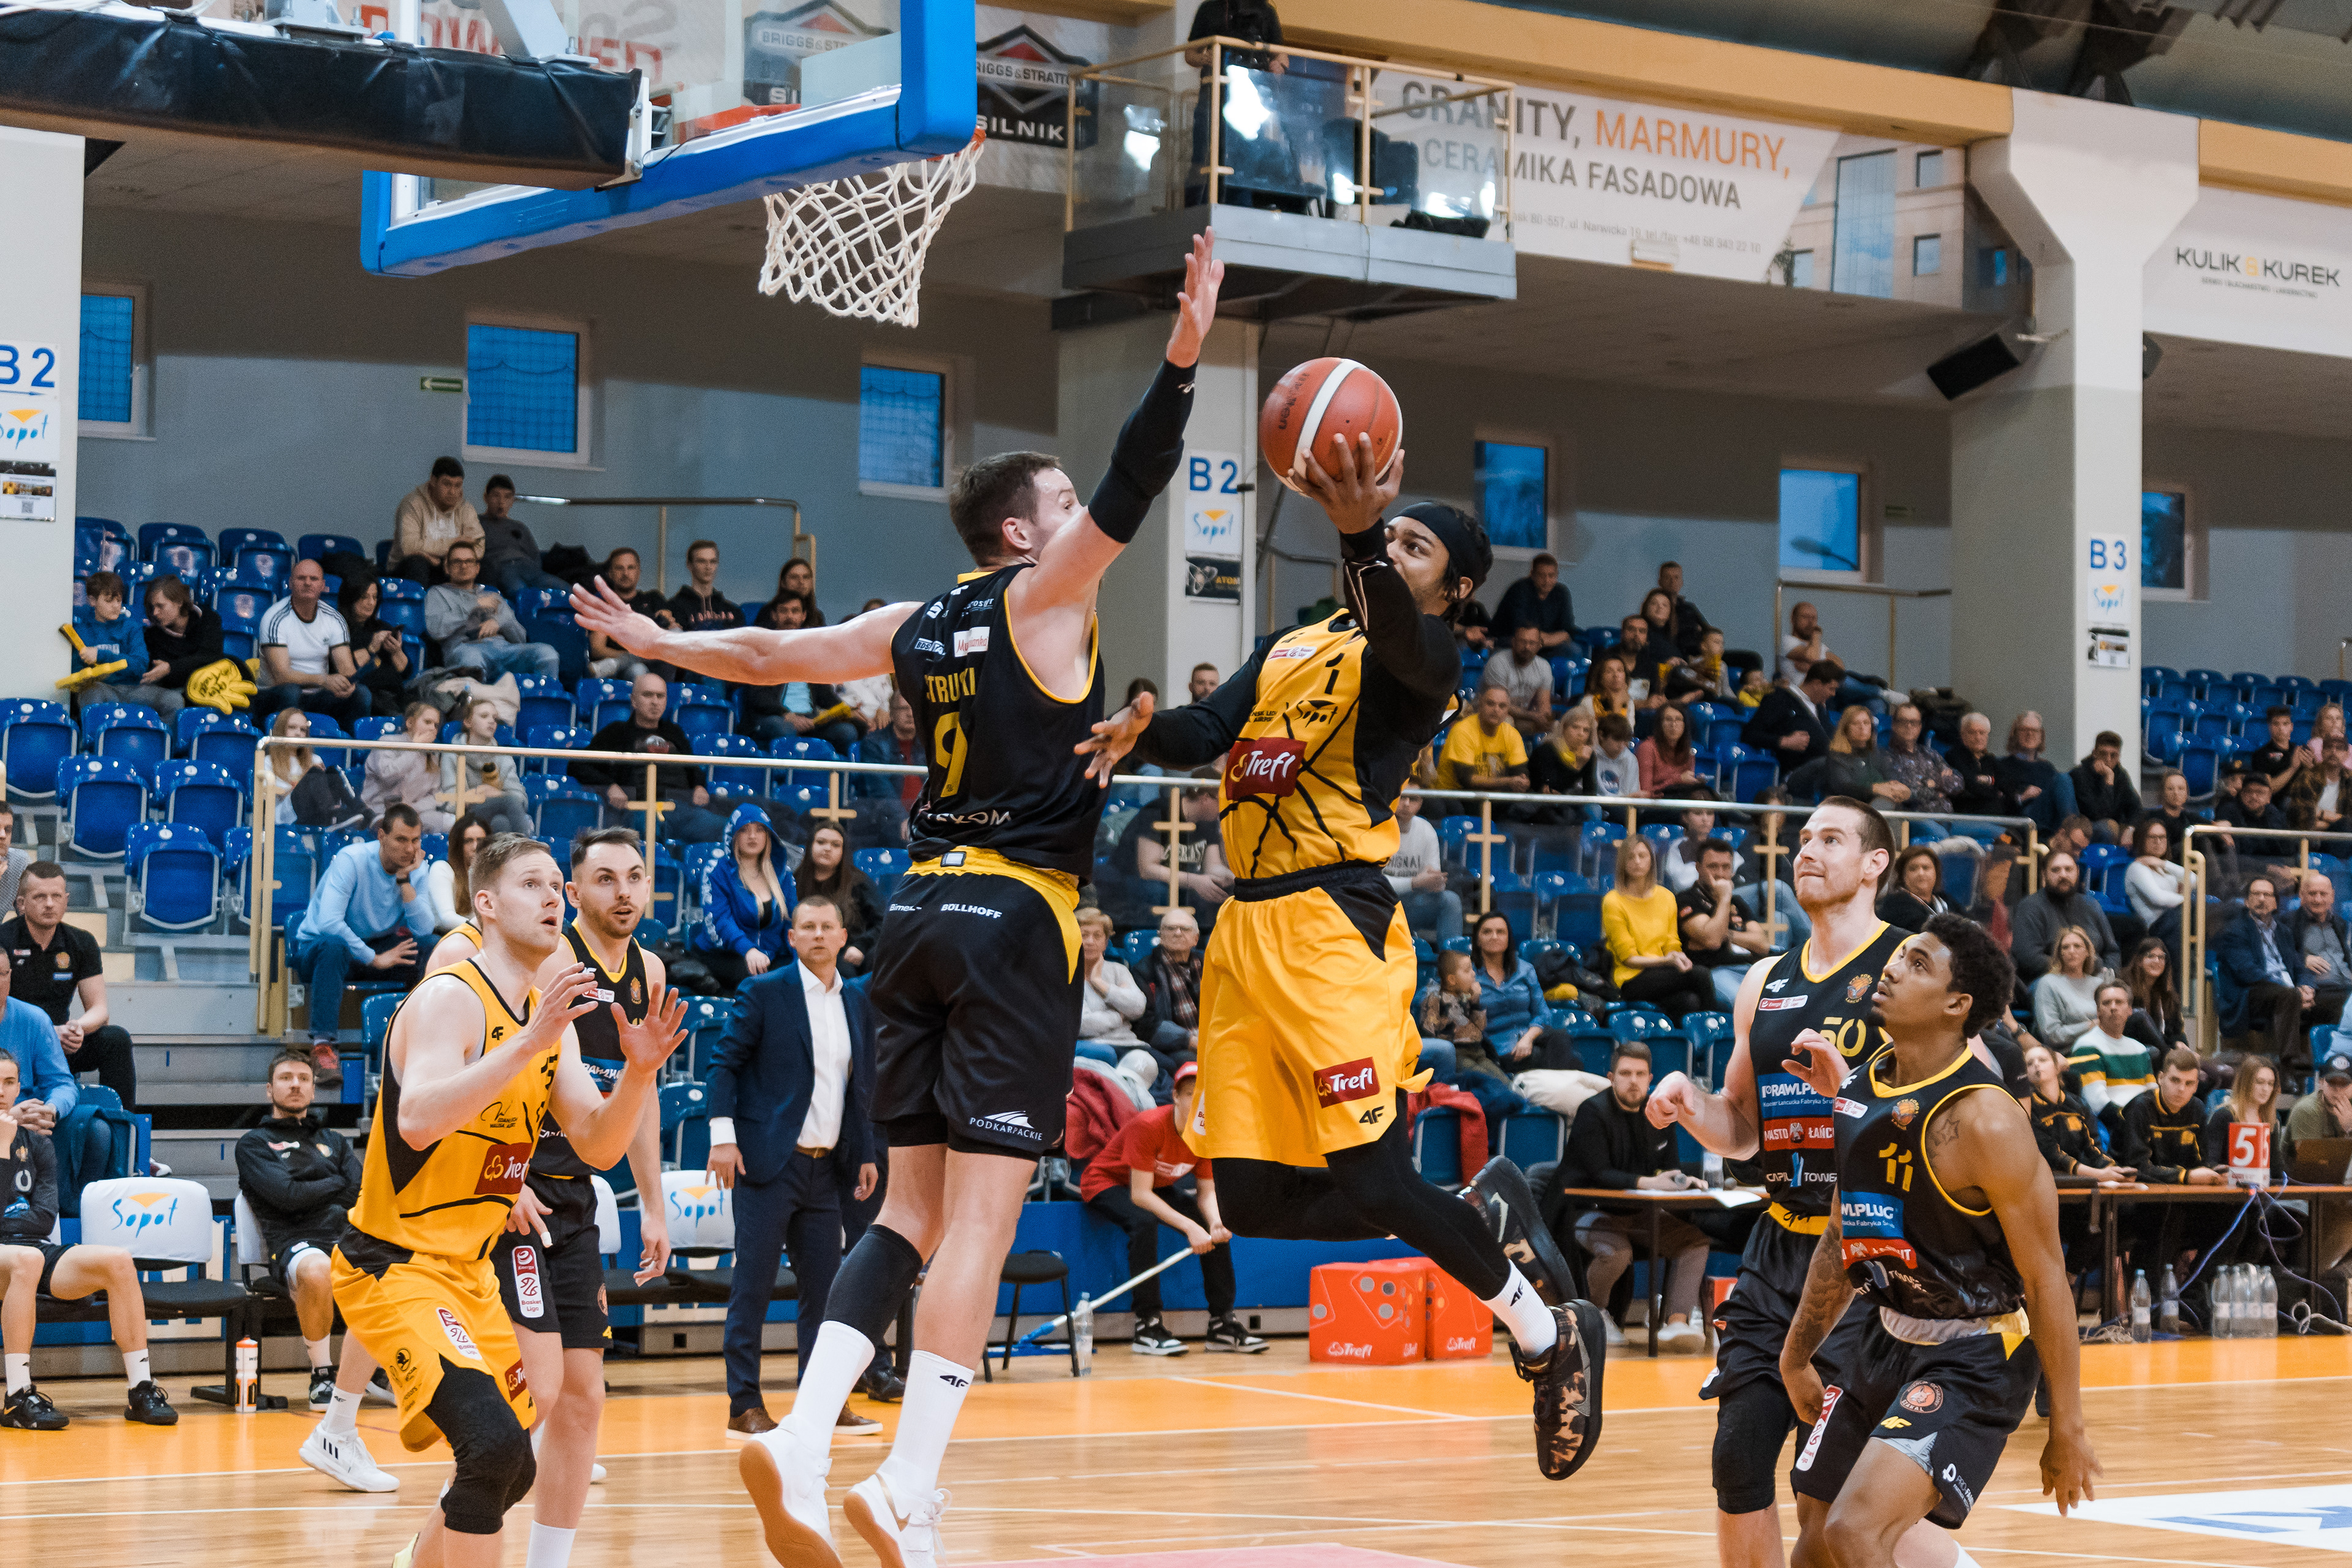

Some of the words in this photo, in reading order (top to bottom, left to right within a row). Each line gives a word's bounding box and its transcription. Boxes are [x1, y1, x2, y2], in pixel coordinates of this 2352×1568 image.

[976, 115, 1065, 141] SILNIK
[1403, 81, 1580, 149] GRANITY,
[1596, 110, 1790, 179] MARMURY,
[1425, 138, 1578, 186] CERAMIKA
[1589, 160, 1741, 209] FASADOWA
[2176, 246, 2241, 274] KULIK
[2263, 258, 2341, 287] KUREK
[1324, 652, 1345, 695] 1
[1294, 700, 1338, 728] Sopot
[934, 711, 968, 797] 9
[1245, 750, 1296, 782] Trefl
[1819, 1016, 1867, 1057] 50
[1330, 1067, 1374, 1093] Trefl
[970, 1116, 1043, 1141] PODKARPACKIE
[1359, 1105, 1385, 1125] 4F
[1879, 1142, 1913, 1192] 11
[2233, 1127, 2257, 1167] 5
[111, 1196, 178, 1238] Sopot
[670, 1189, 725, 1229] Sopot
